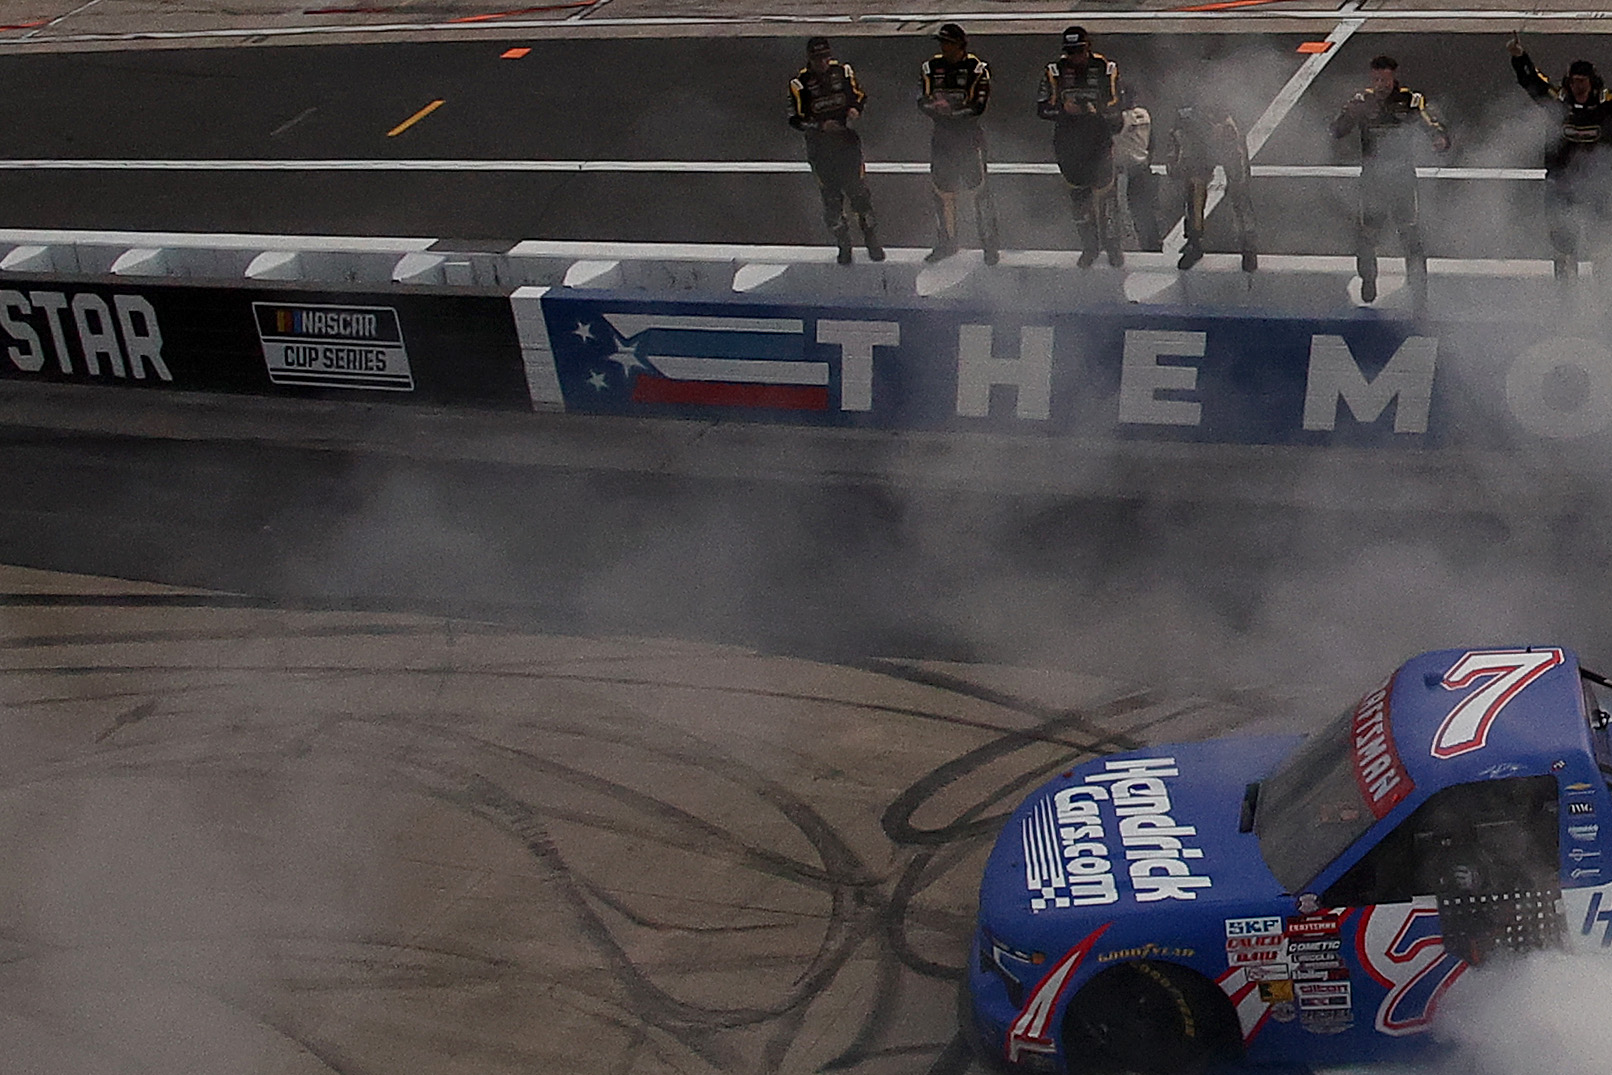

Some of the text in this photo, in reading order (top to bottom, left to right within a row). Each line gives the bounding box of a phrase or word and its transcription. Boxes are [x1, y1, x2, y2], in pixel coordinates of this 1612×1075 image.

[0, 289, 173, 382] STAR
[284, 345, 387, 371] CUP SERIES
[302, 310, 378, 337] NASCAR
[815, 319, 1208, 425] THE
[1354, 682, 1401, 803] AFTSMAN
[1430, 646, 1564, 759] 7
[1053, 784, 1120, 907] Cars.com
[1084, 756, 1213, 903] Hendrick
[1228, 919, 1280, 935] SKF
